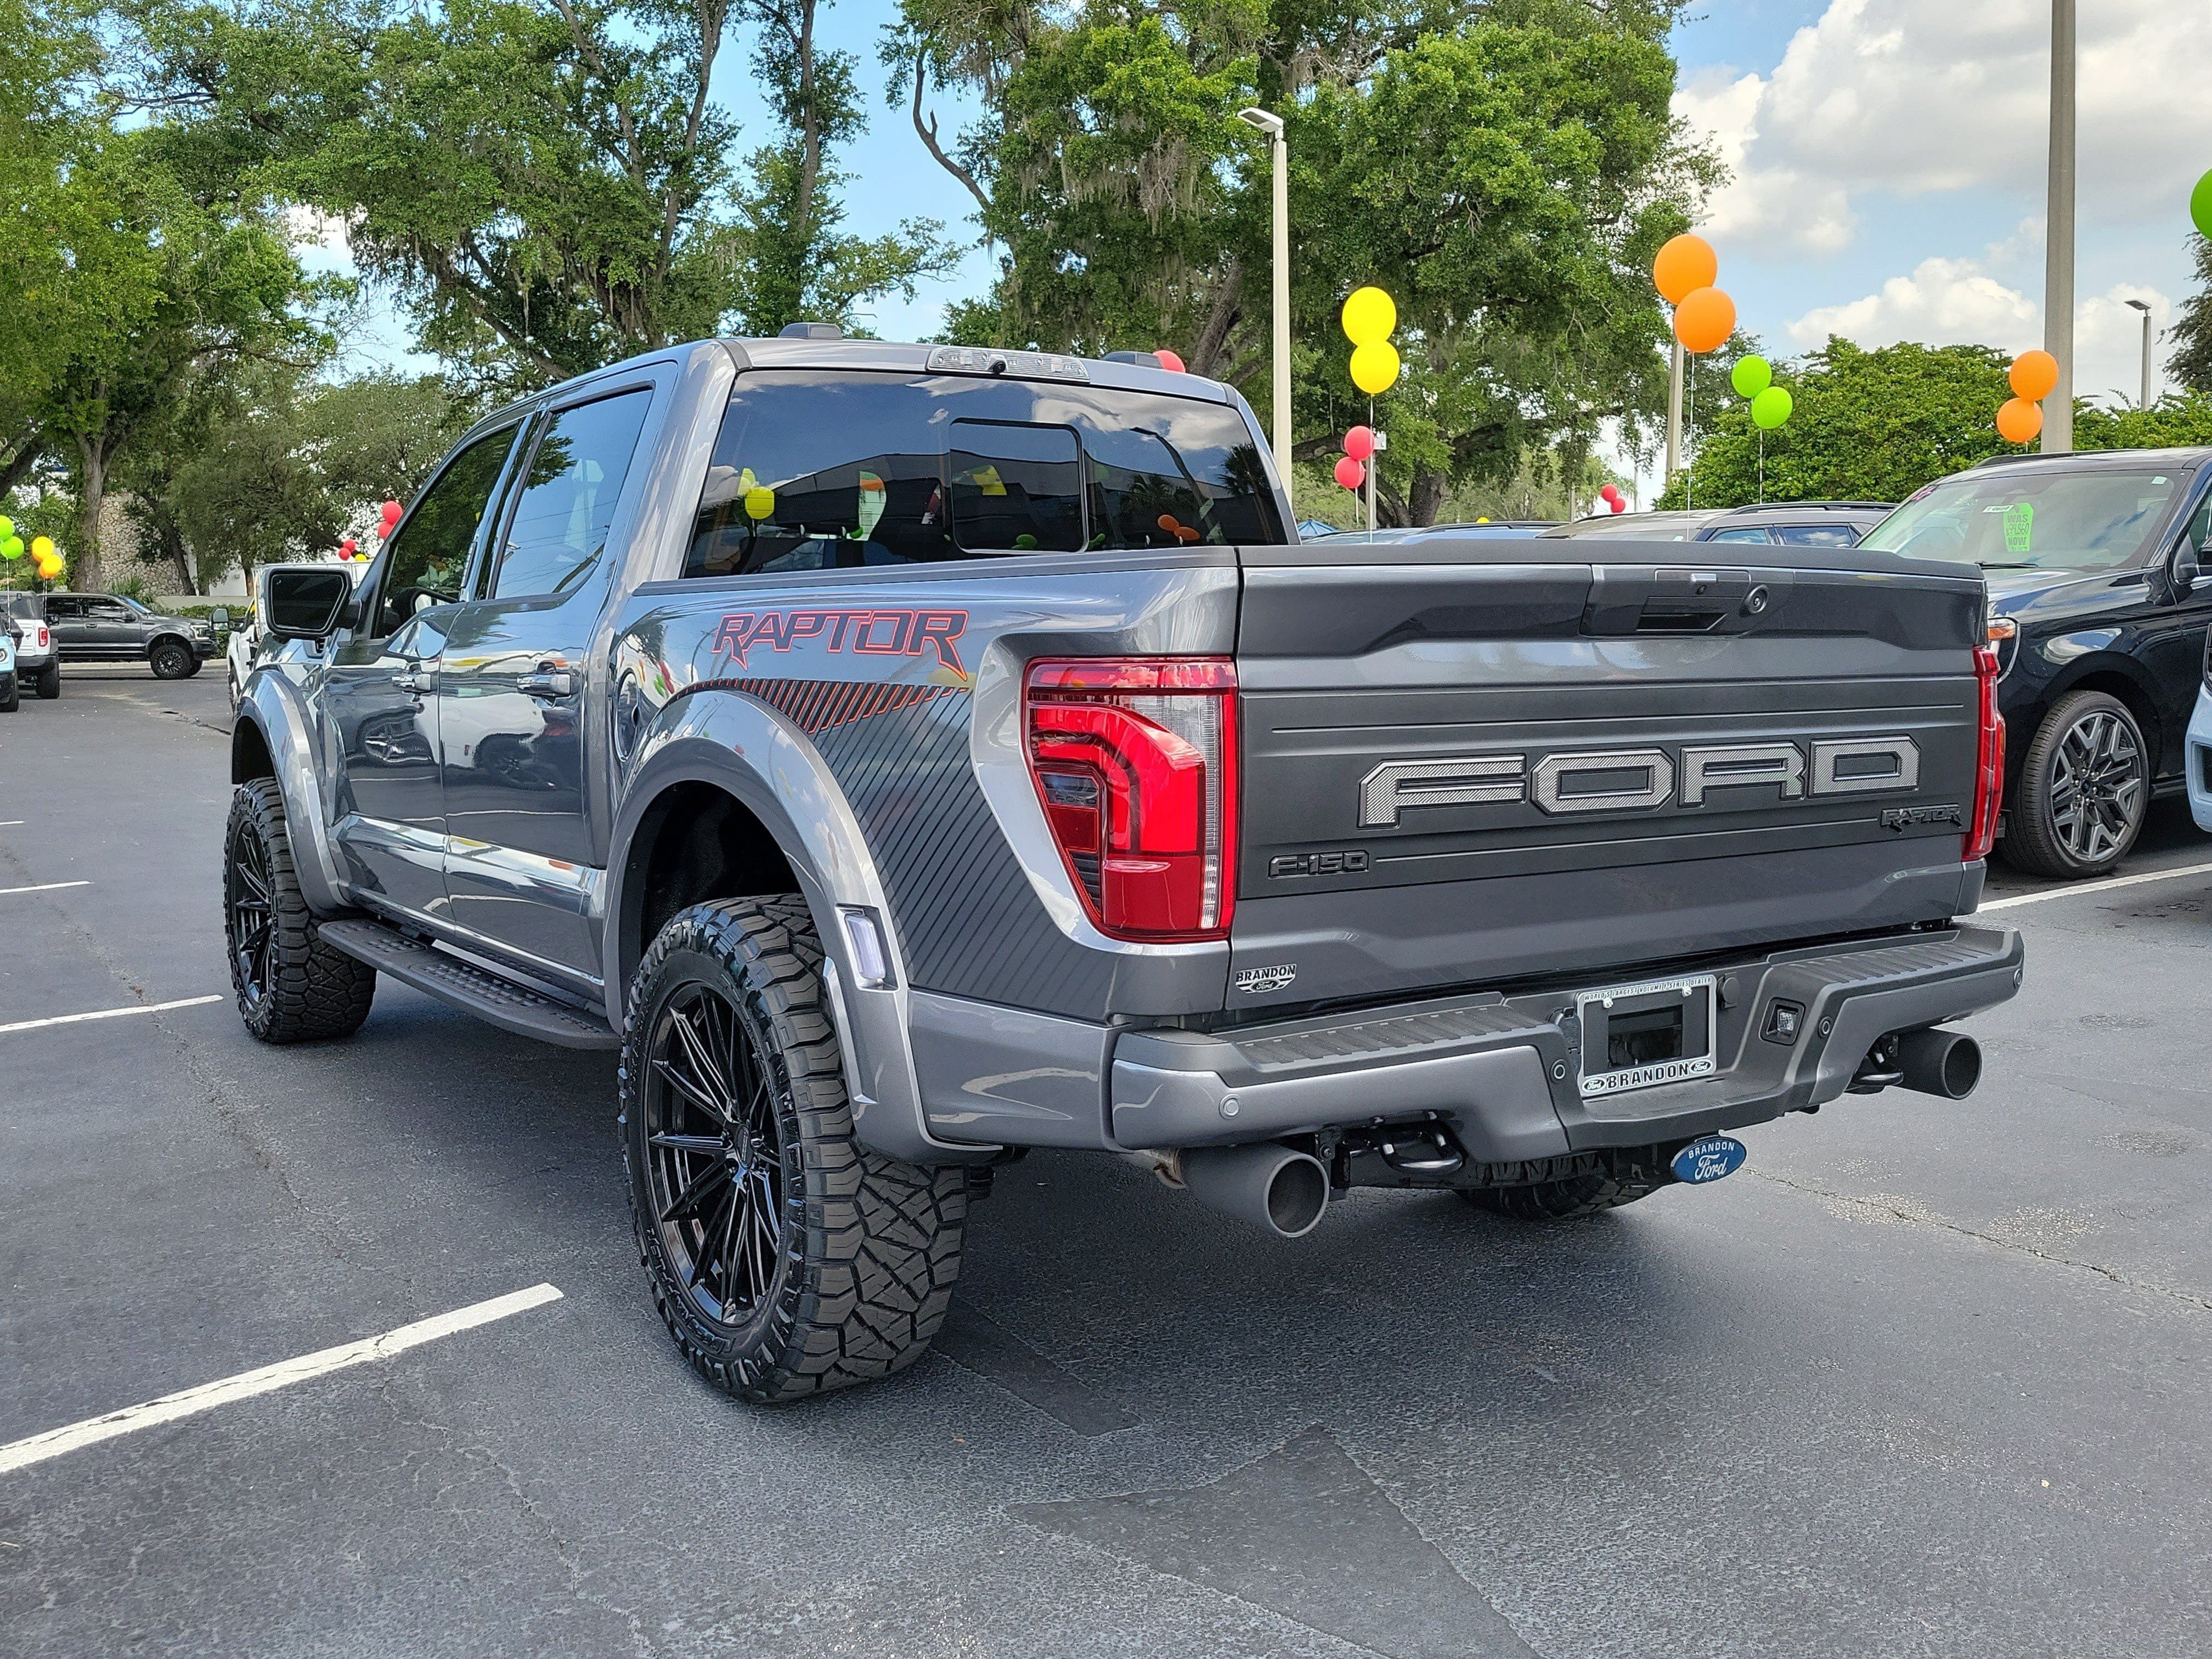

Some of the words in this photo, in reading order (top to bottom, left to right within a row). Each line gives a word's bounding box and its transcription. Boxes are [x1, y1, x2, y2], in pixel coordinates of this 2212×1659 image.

[2008, 514, 2028, 523] WAS
[2007, 537, 2027, 546] NOW
[712, 609, 969, 682] RAPTOR
[1357, 736, 1922, 829] FORD
[1881, 803, 1962, 834] RAPTOR
[1268, 850, 1370, 879] F-150
[1235, 965, 1295, 982] BRANDON
[1612, 987, 1638, 996] LARGEST
[1639, 984, 1662, 992] VOLUME
[1691, 977, 1711, 985] DEALER
[1606, 1062, 1690, 1089] BRANDON
[1688, 1142, 1735, 1159] BRANDON
[1694, 1153, 1728, 1180] Ford
